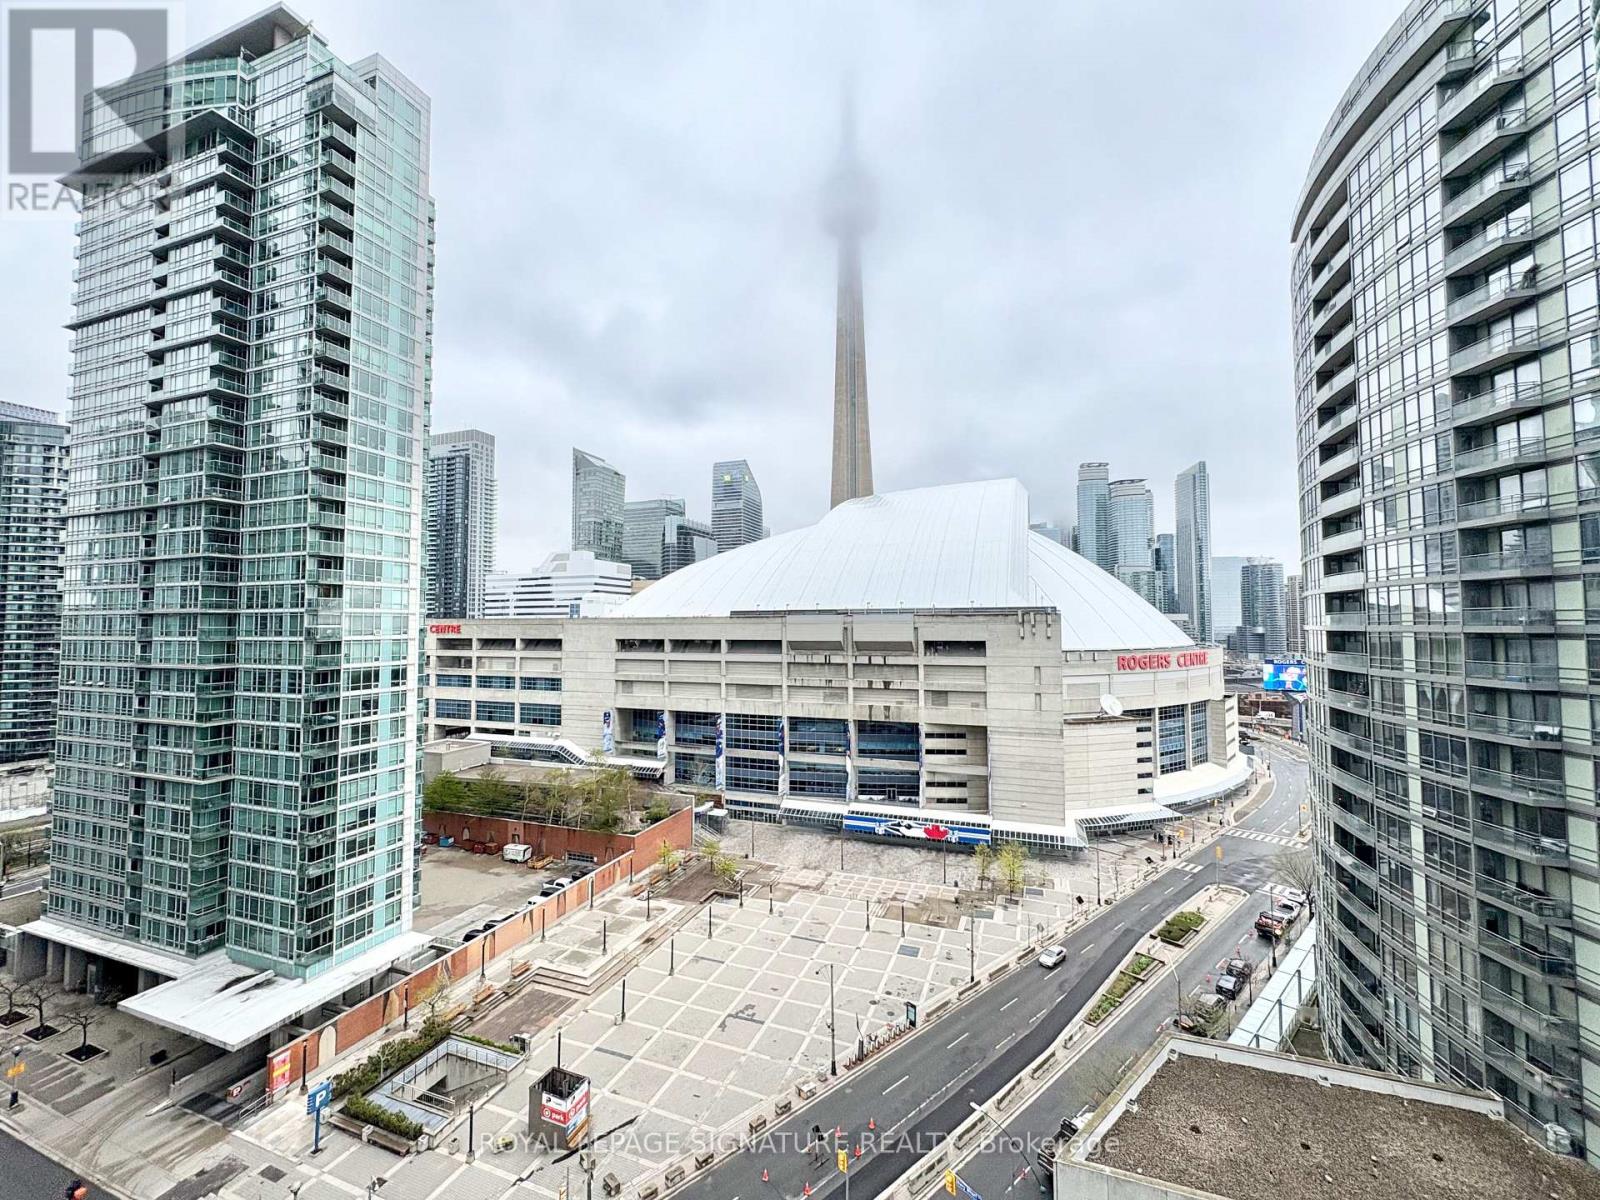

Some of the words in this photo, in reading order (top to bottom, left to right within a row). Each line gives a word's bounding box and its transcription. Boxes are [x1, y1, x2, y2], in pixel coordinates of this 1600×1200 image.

[430, 623, 462, 634] CENTRE
[1117, 653, 1172, 671] ROGERS
[1177, 651, 1209, 667] CENTRE
[315, 1090, 327, 1107] P
